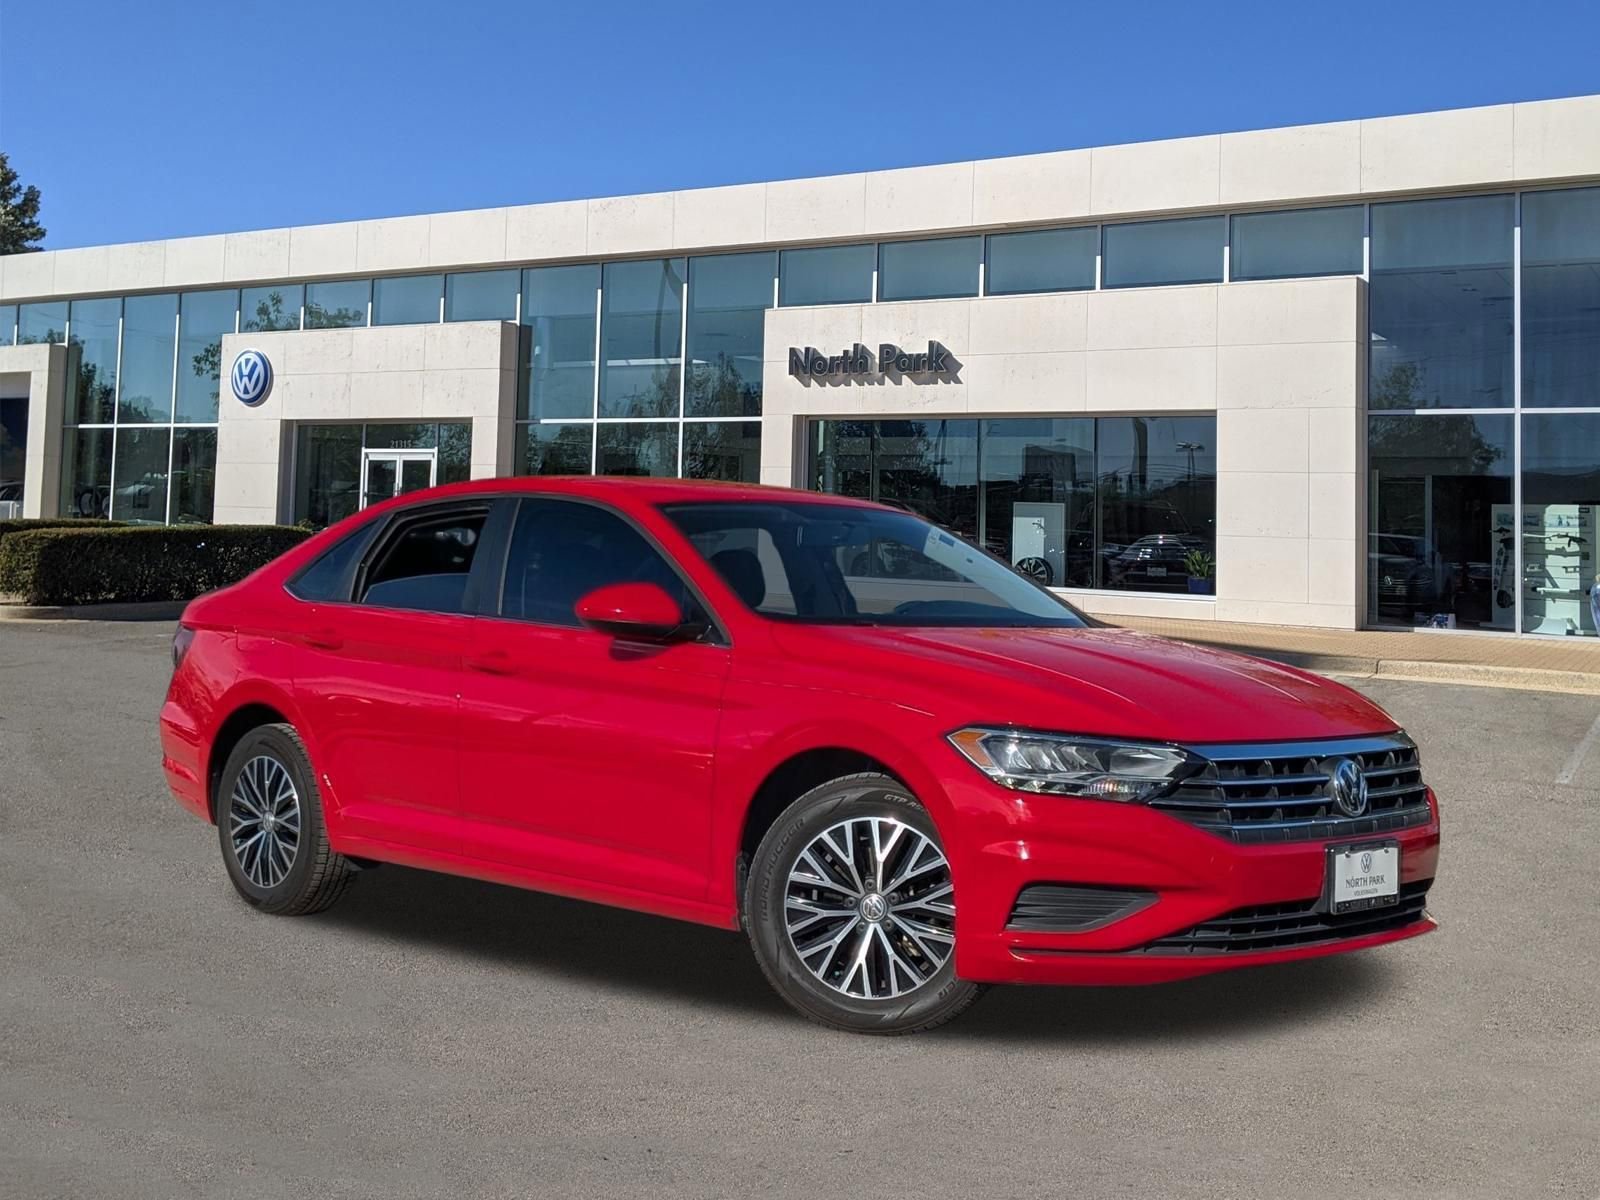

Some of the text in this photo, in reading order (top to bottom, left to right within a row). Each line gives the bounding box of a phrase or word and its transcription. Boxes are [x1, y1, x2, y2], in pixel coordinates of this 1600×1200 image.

[788, 340, 948, 376] North Park
[231, 350, 269, 403] VW
[390, 439, 411, 449] 21315
[1345, 874, 1386, 889] NORTH PARK
